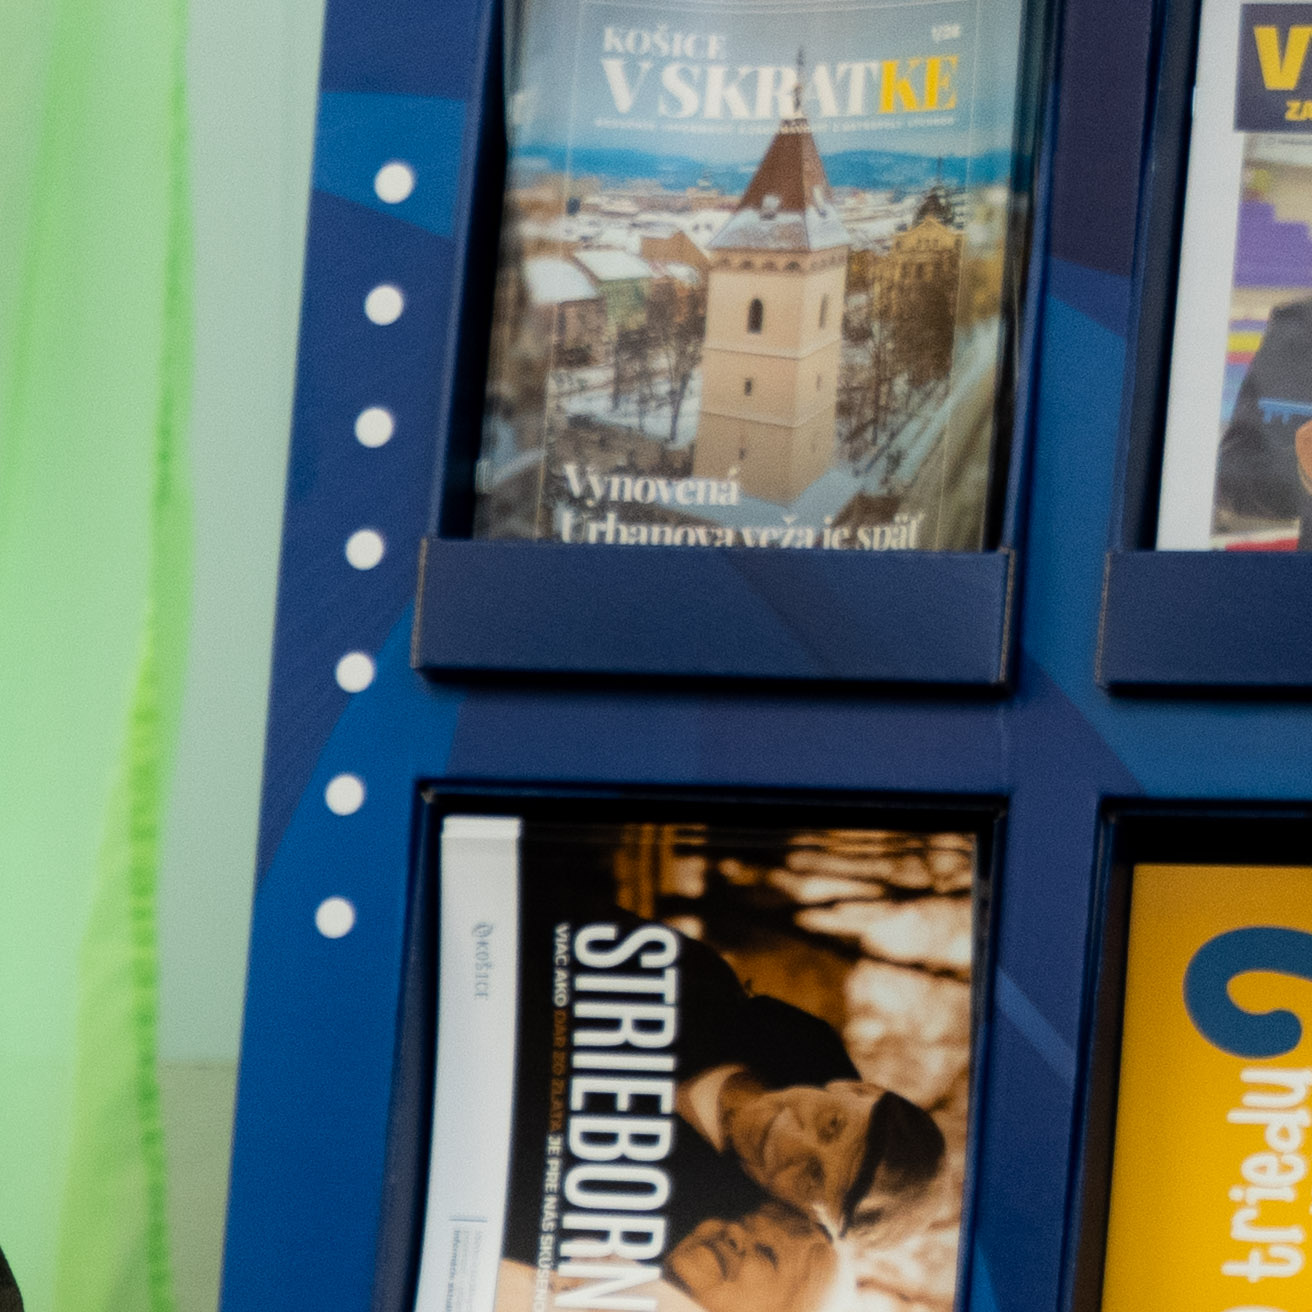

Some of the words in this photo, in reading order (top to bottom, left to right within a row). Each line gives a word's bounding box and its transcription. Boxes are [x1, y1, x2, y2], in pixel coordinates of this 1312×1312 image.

[602, 24, 727, 60] KOŠICE
[601, 58, 653, 114] V
[658, 55, 959, 120] SKRATKE
[564, 464, 741, 508] Vynovená
[554, 922, 571, 966] VIAC
[474, 941, 494, 1000] KOŠICE
[552, 967, 569, 1008] AKO
[547, 1133, 564, 1158] JE
[544, 1158, 563, 1193] PRE
[541, 1195, 559, 1232] NÁS
